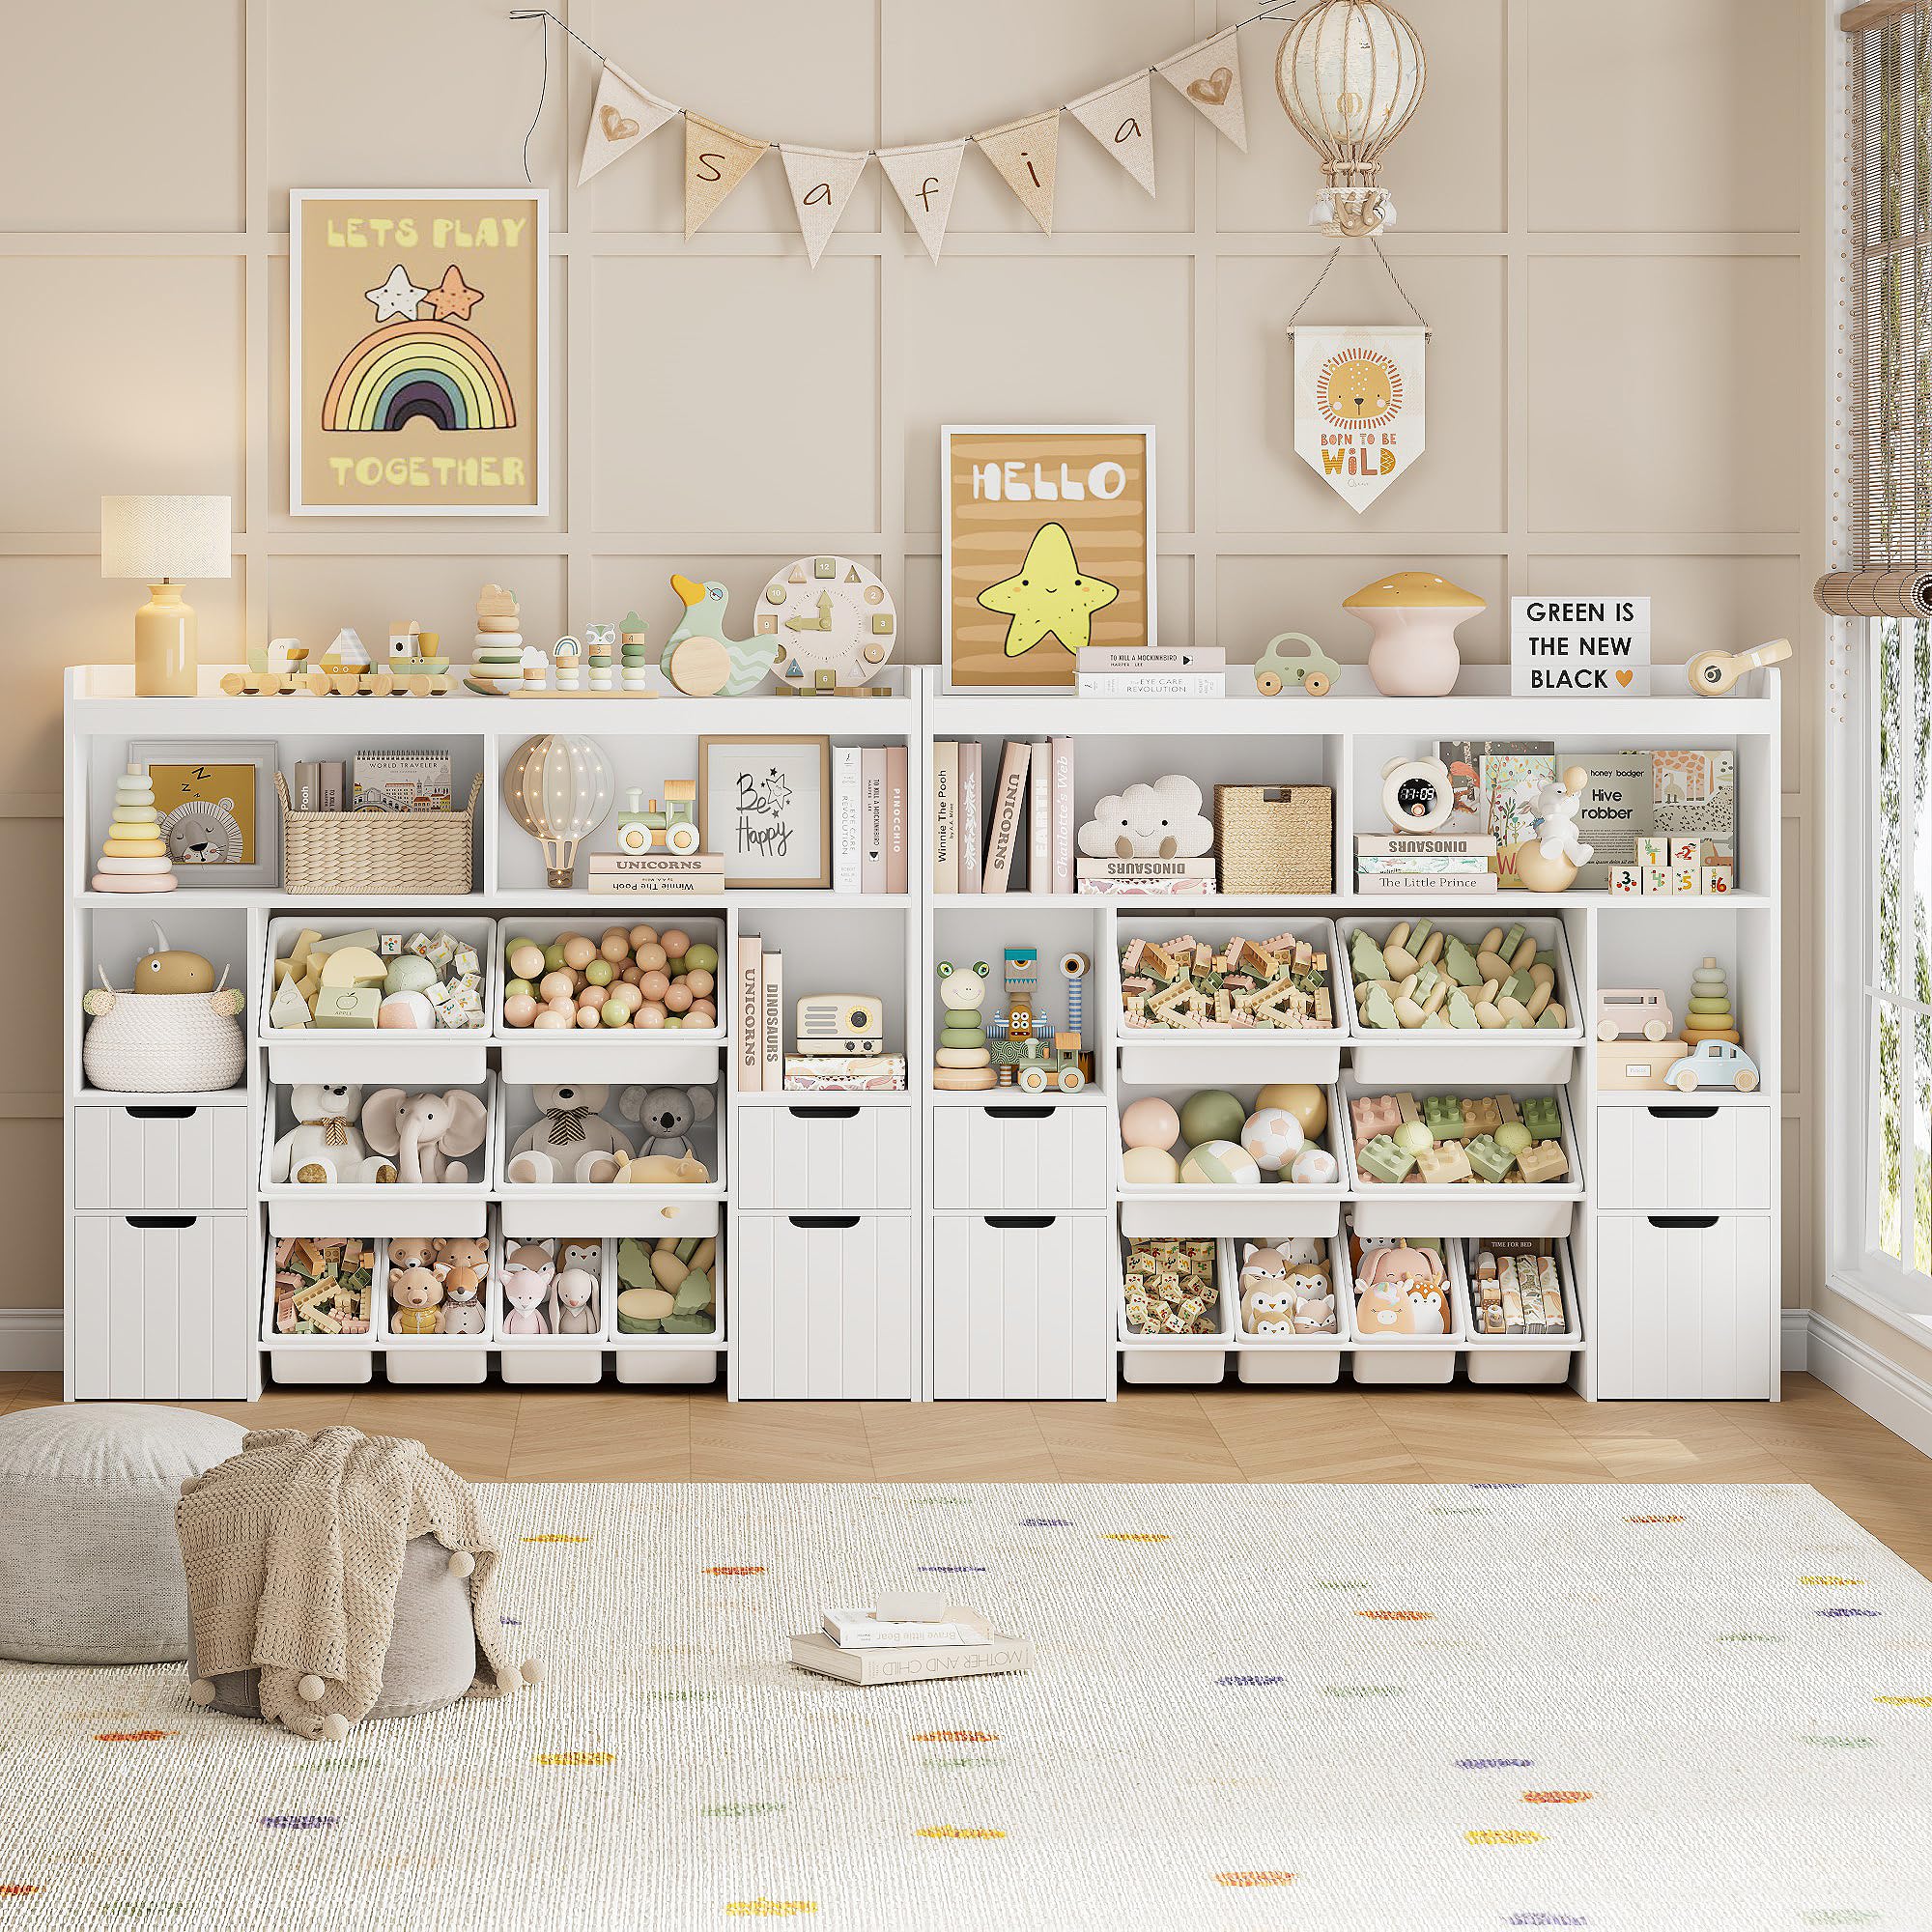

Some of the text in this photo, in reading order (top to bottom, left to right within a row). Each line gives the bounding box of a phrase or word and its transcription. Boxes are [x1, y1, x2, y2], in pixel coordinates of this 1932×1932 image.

[327, 218, 526, 247] LETS PLAY
[1321, 434, 1397, 445] BORN TO BE
[328, 457, 526, 486] TOGETHER
[973, 462, 1126, 500] HELLO
[1526, 603, 1634, 622] GREEN IS
[1529, 638, 1632, 655] THE NEW
[1531, 669, 1608, 688] BLACK
[736, 772, 771, 814] Be
[1592, 789, 1622, 802] Hive
[938, 770, 947, 863] Winnie The Pooh
[1036, 779, 1048, 858] EARTH
[1057, 756, 1068, 877] Charlotte's Web
[1581, 807, 1634, 819] robber
[994, 774, 1020, 870] UNICORNS
[736, 815, 793, 857] Happy
[1388, 840, 1467, 852] DINOSAURS
[1682, 845, 1691, 860] 2
[1649, 852, 1656, 865] 1
[1107, 863, 1185, 874] DINOSAURS
[1379, 877, 1477, 887] The Little Prince
[1621, 870, 1632, 885] 3
[1653, 872, 1662, 887] 4
[1682, 875, 1692, 890] 5
[1717, 876, 1727, 893] 6
[745, 968, 755, 1066] UNICORNS
[766, 983, 779, 1063] DINOSAURS
[876, 1632, 901, 1641] Bear
[903, 1632, 925, 1641] little
[927, 1631, 956, 1640] Brave
[926, 1656, 960, 1672] AND
[963, 1649, 1023, 1668] MOTHER
[882, 1660, 923, 1676] CHILD
